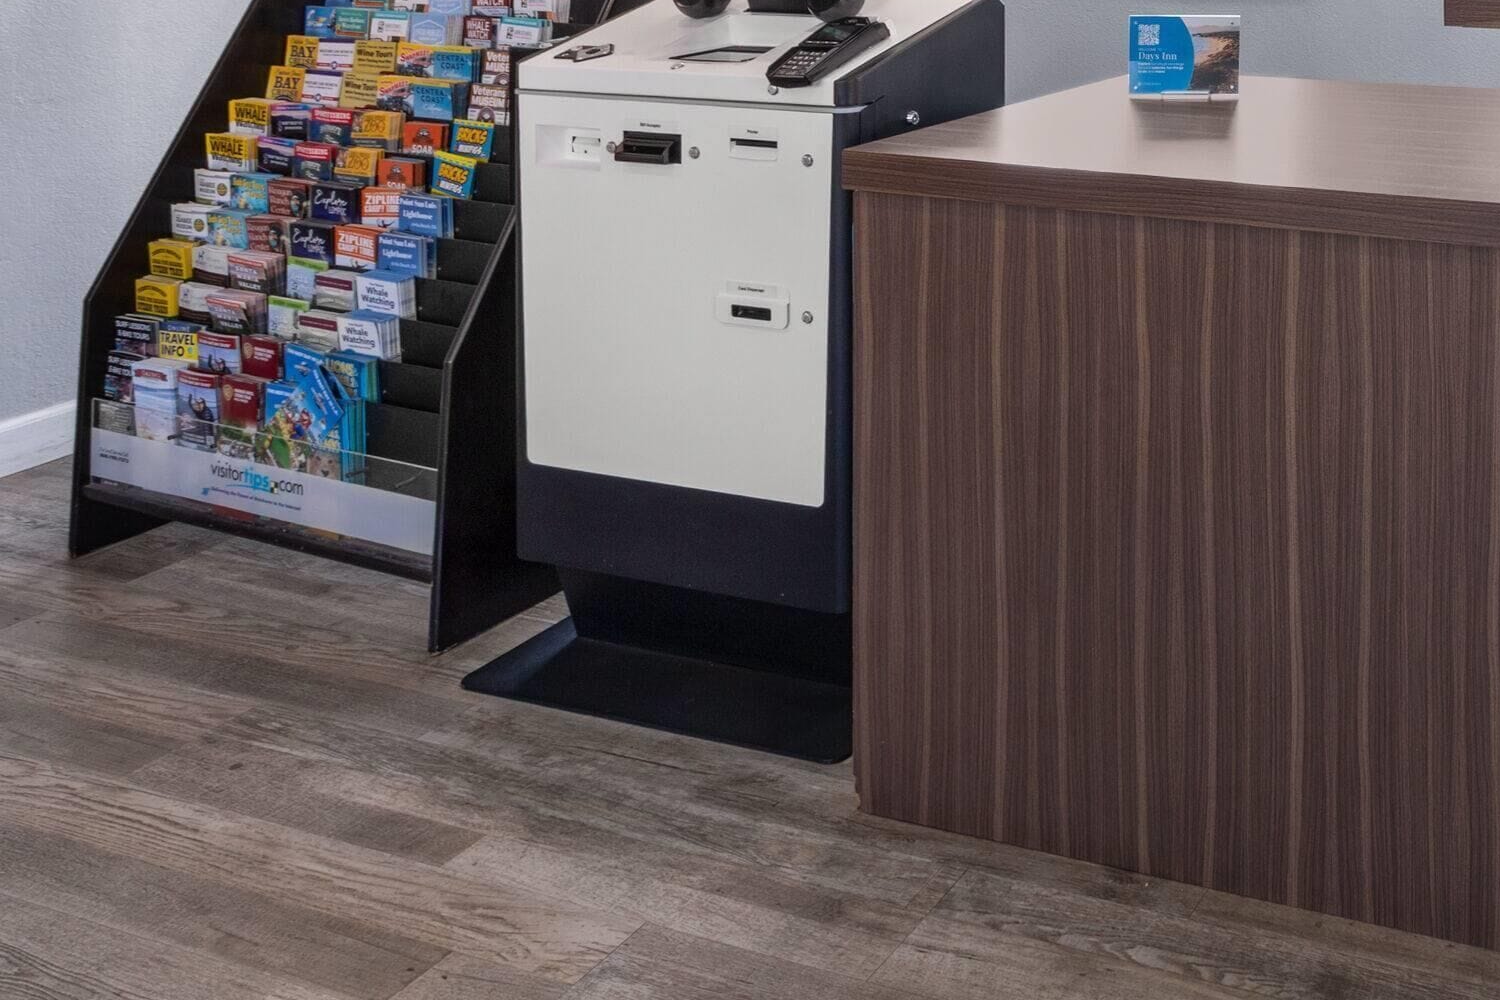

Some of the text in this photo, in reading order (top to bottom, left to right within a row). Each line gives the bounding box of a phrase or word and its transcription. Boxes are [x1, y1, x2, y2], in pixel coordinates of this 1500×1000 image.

[466, 20, 491, 31] WHALE
[467, 30, 489, 40] WATCH
[290, 45, 317, 59] BAY
[356, 48, 374, 57] Wine
[376, 49, 393, 58] Tours
[436, 54, 468, 62] CENTRAL
[486, 51, 510, 62] Veter
[1138, 51, 1177, 62] Days Inn
[440, 61, 466, 71] COAST
[485, 61, 510, 73] MUSE
[274, 76, 301, 89] BAY
[344, 80, 362, 90] Wine
[420, 94, 444, 103] COAST
[470, 96, 505, 108] MUSEUM
[235, 106, 266, 121] WHALE
[456, 126, 488, 145] BRICKS
[210, 140, 243, 156] WHALE
[411, 144, 433, 155] SOAR
[438, 162, 469, 184] BRICKS
[314, 189, 348, 210] Explore
[365, 194, 400, 205] ZIPLINE
[400, 197, 414, 206] Point
[402, 209, 433, 221] Lighthouse
[292, 228, 326, 248] Explore
[338, 233, 374, 248] ZIPLINE
[379, 236, 393, 245] Point
[382, 248, 413, 260] Lighthouse
[239, 281, 261, 291] VALLEY
[365, 286, 389, 298] Whale
[361, 294, 396, 310] Watching
[345, 326, 369, 338] Whale
[161, 331, 195, 346] TRAVEL
[341, 334, 376, 349] Watching
[161, 345, 185, 357] INFO
